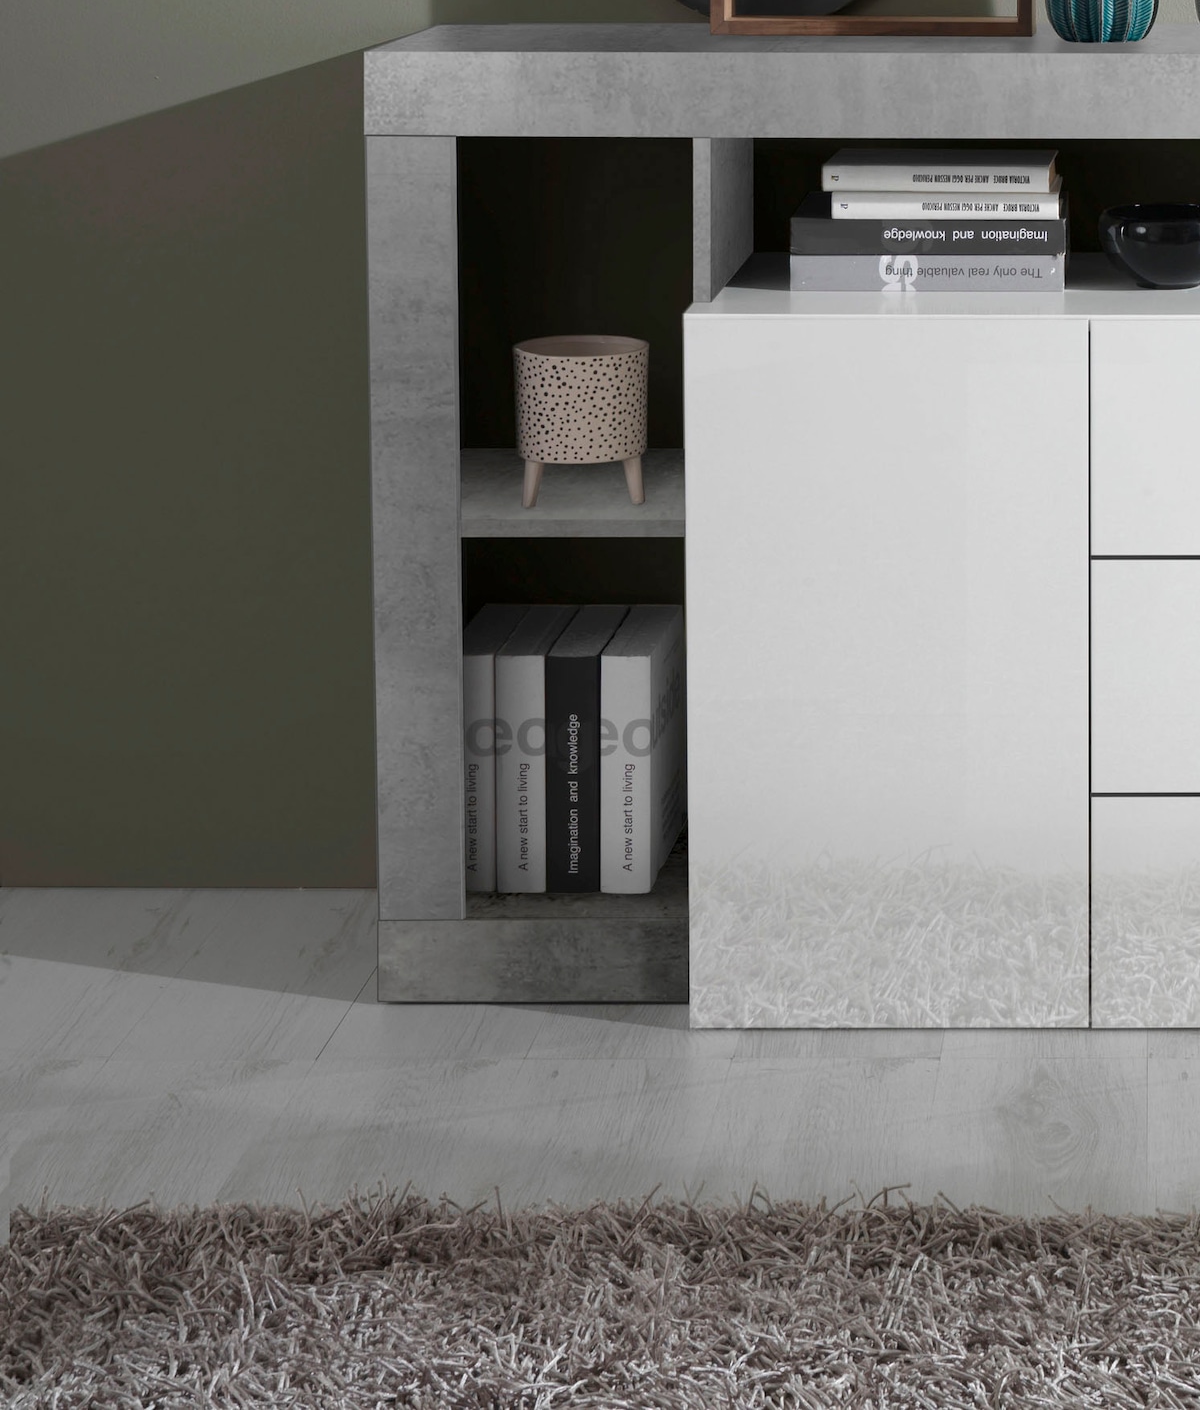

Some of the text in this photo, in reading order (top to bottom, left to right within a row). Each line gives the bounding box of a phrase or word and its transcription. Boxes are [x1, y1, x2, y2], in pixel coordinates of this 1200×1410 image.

[934, 174, 951, 183] NESSUN
[951, 174, 963, 183] OGGI
[964, 174, 974, 183] PER
[974, 175, 990, 184] ANCHE
[993, 175, 1008, 184] BRUCE
[1009, 175, 1031, 184] VICTORIA
[943, 202, 960, 211] NESSUN
[961, 202, 973, 211] OGGI
[974, 202, 983, 211] PER
[984, 203, 999, 212] ANCHE
[1003, 203, 1018, 212] BRUCE
[1019, 203, 1040, 212] VICTORIA
[884, 227, 1048, 241] Imagination and knowledge
[885, 264, 1043, 280] The only real valuable thing
[567, 713, 581, 874] Imagination and knowledge
[465, 763, 479, 872] A new start to living
[517, 763, 530, 871] A new start to living
[622, 763, 636, 872] A new start to living
